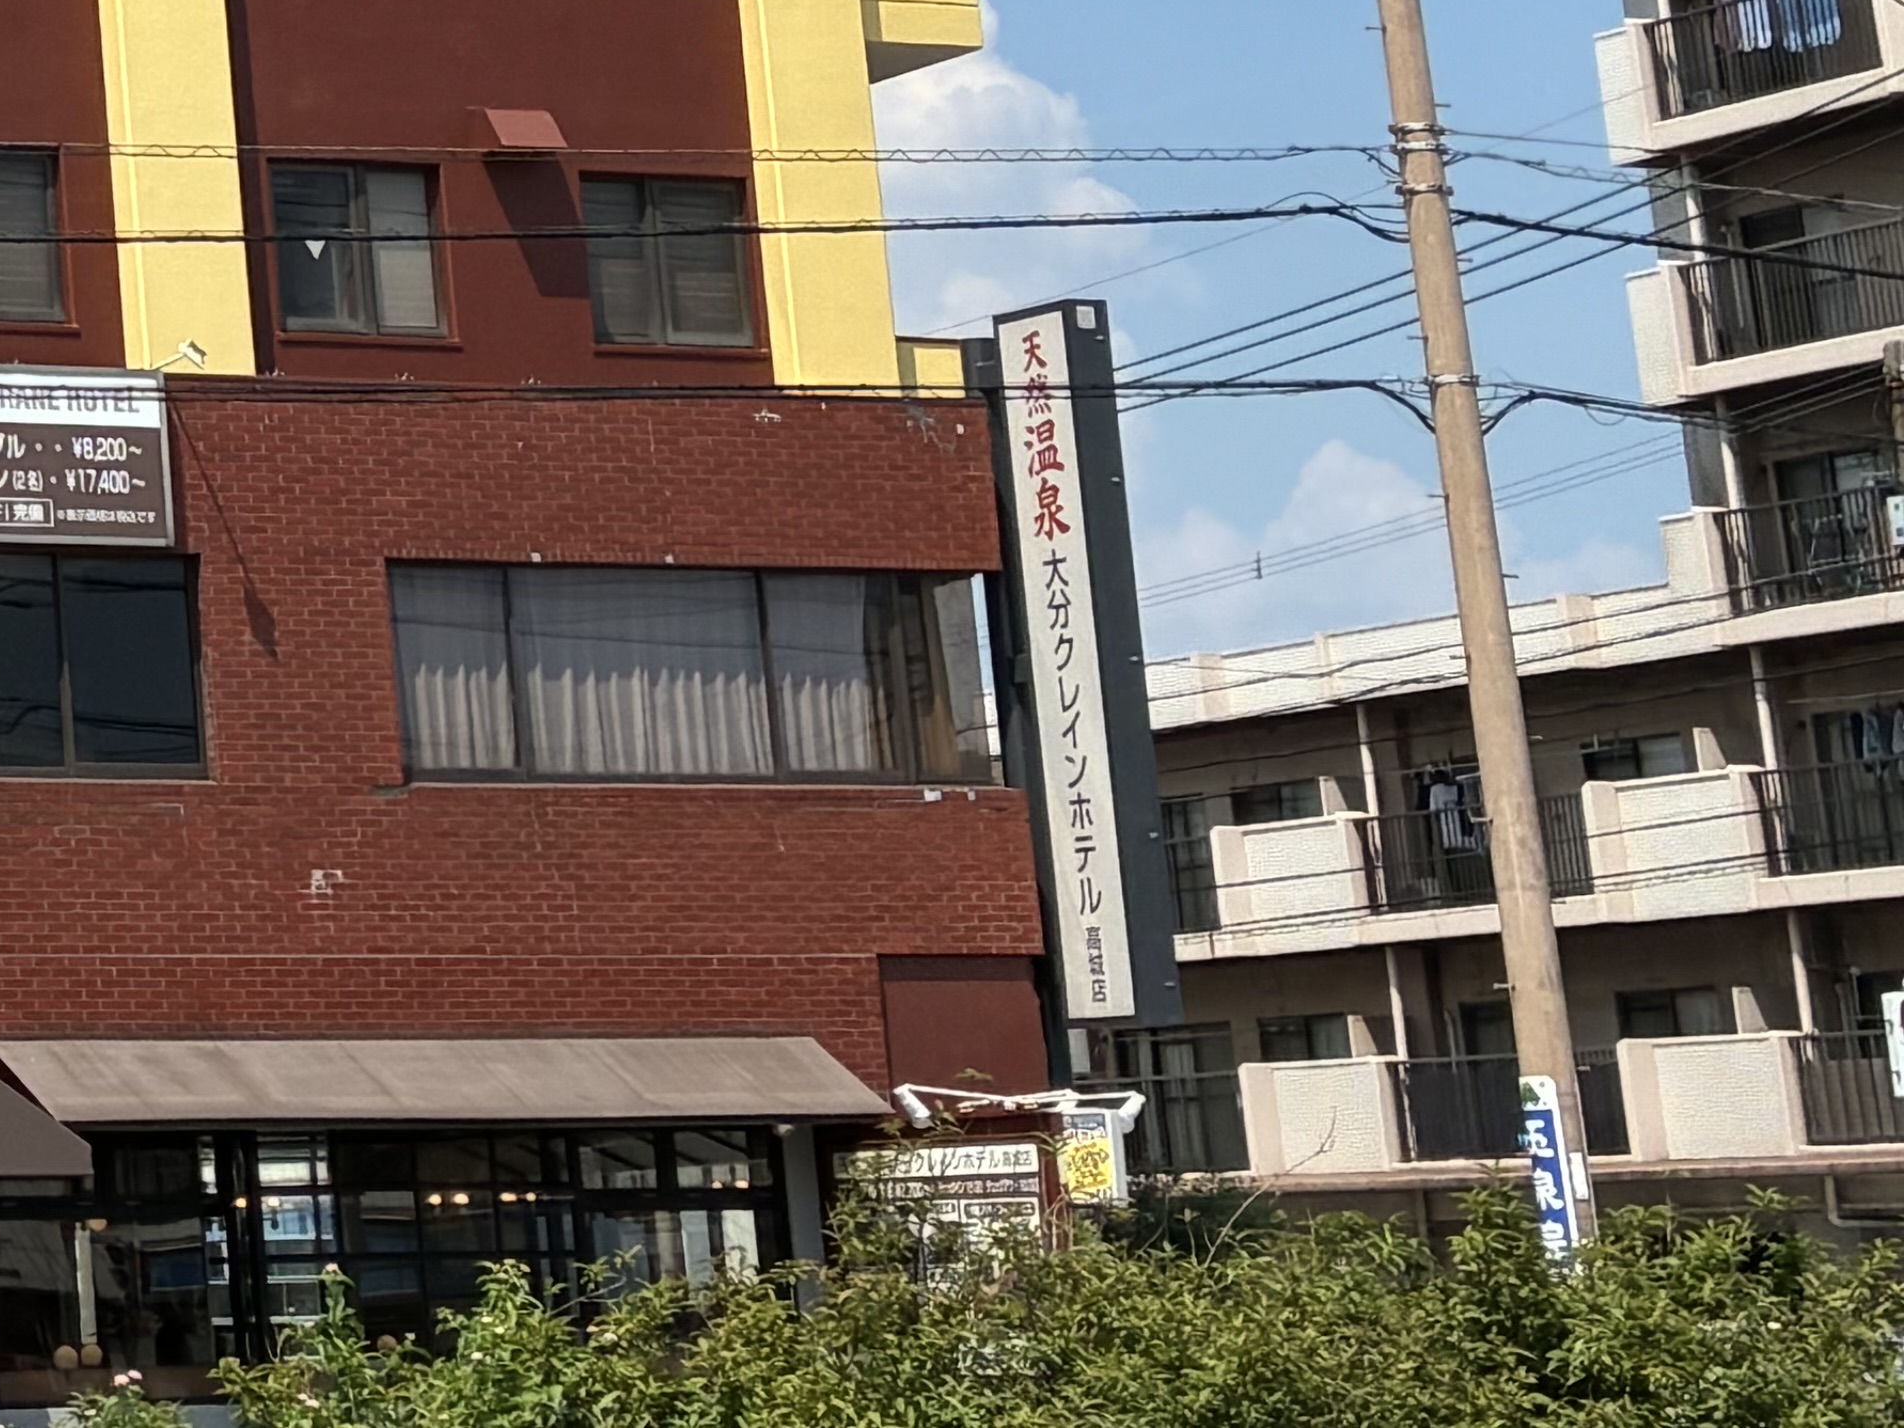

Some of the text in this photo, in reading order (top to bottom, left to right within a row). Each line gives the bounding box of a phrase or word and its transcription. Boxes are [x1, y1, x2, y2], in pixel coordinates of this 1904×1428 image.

[1021, 329, 1072, 542] 天然温泉
[1042, 548, 1102, 915] 大分クレインホテル
